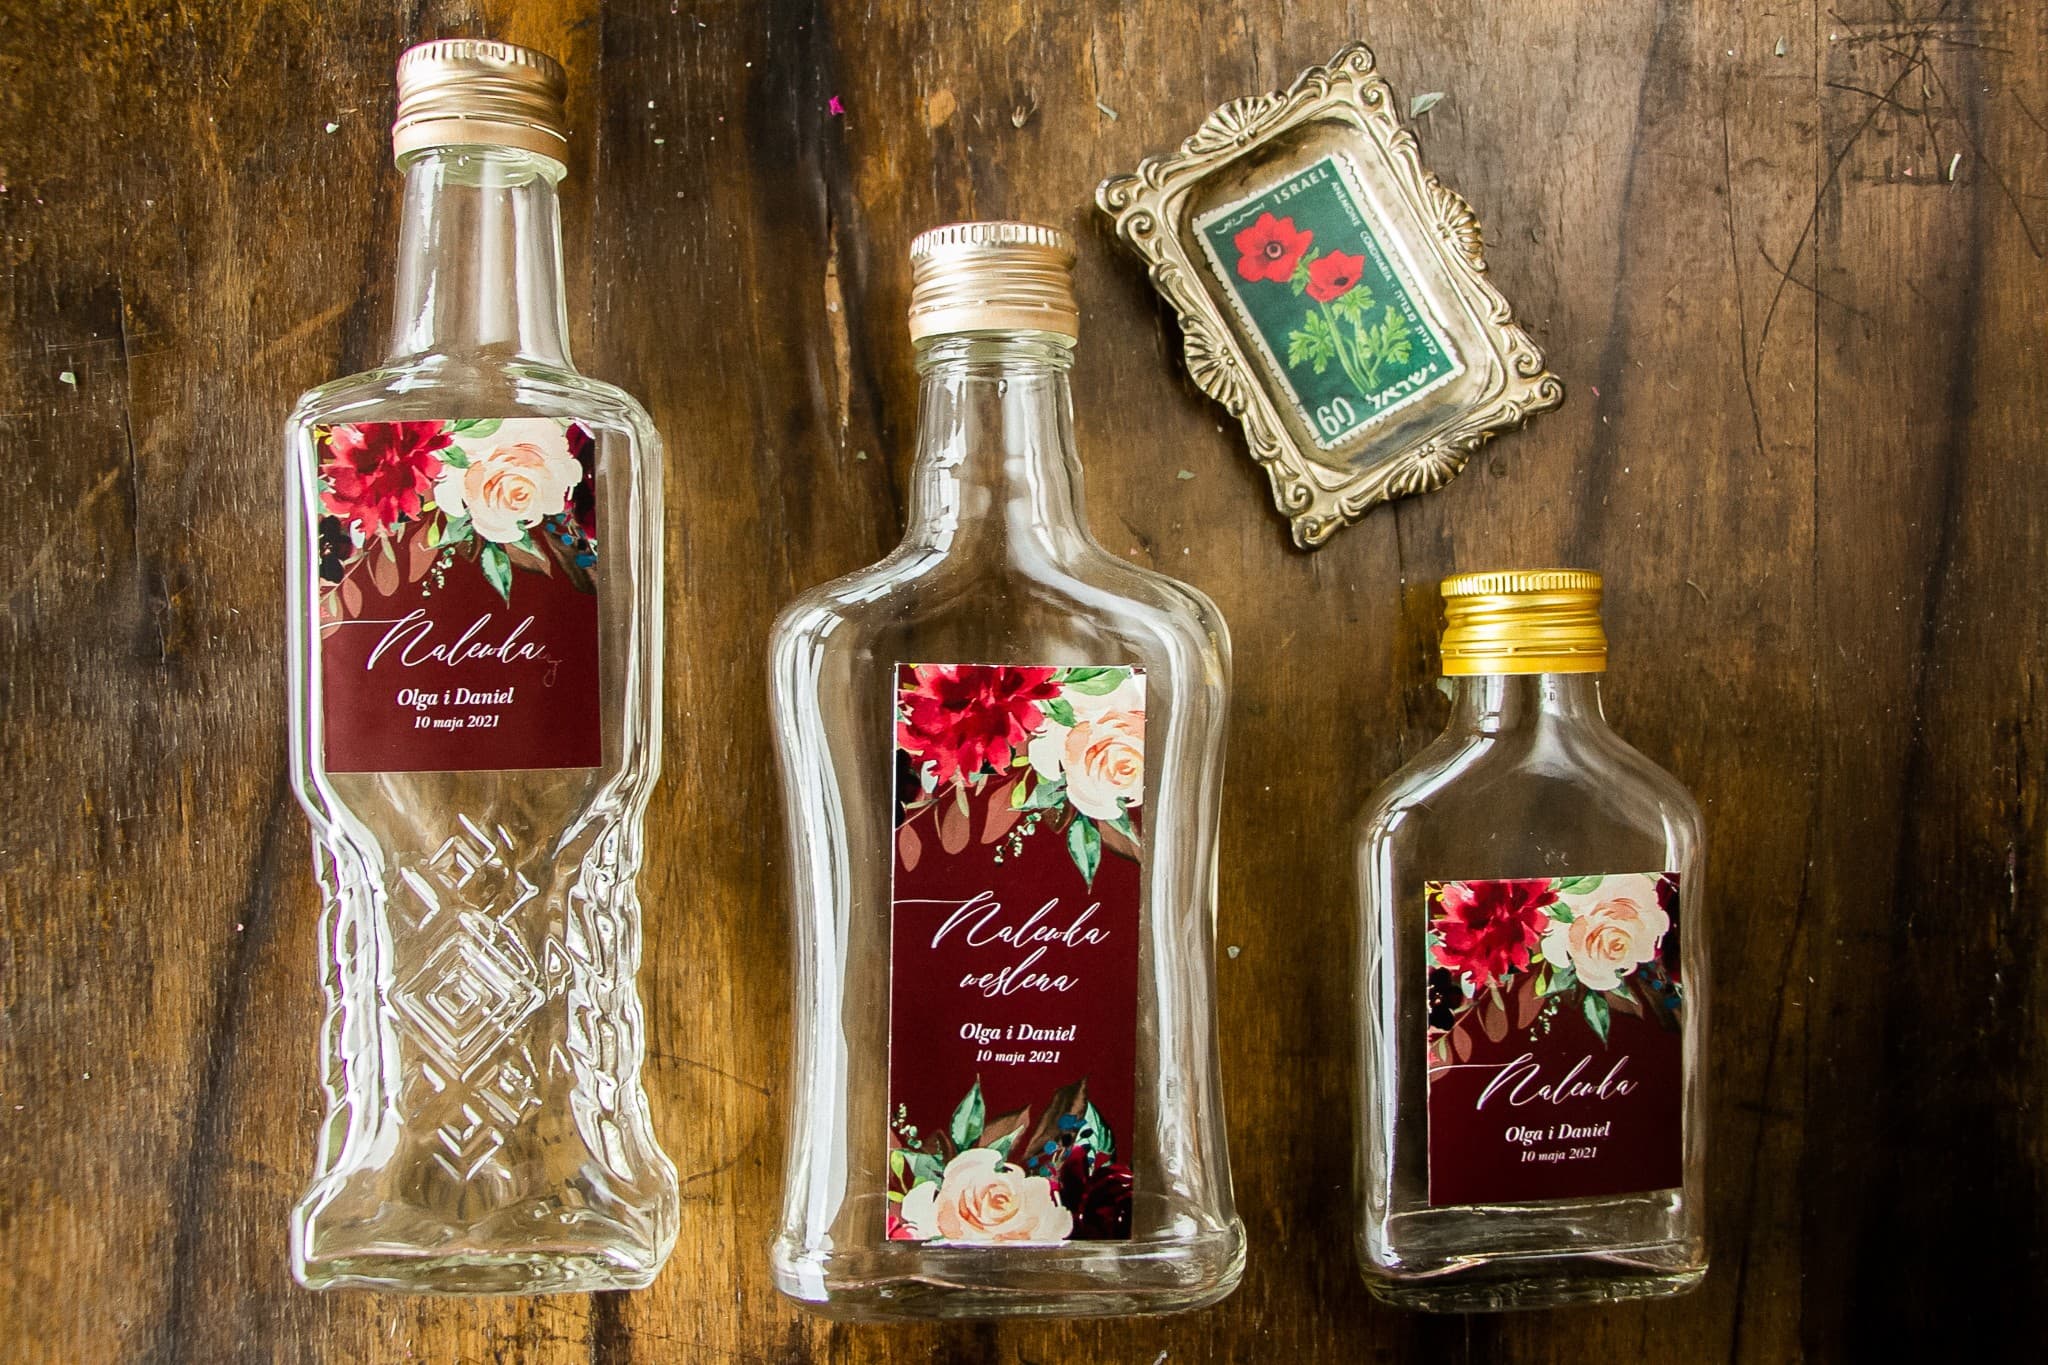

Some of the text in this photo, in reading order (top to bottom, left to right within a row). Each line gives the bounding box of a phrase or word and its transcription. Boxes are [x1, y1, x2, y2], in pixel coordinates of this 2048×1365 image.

[1273, 166, 1330, 205] ISRAEL
[1330, 181, 1392, 283] ANEMONE CORONARIA
[1364, 363, 1438, 413] ישראל
[1316, 396, 1356, 436] 60
[320, 608, 546, 671] Nalewka
[397, 687, 514, 711] Olga i Daniel
[414, 715, 500, 733] 10 maja 2021
[893, 890, 1110, 949] Nalewka
[959, 1023, 1077, 1046] Olga i Daniel
[975, 1049, 1061, 1065] 10 maja 2021
[1429, 1052, 1639, 1111] Nalewka
[1504, 1121, 1611, 1146] Olga i Daniel
[1521, 1146, 1597, 1164] 10 maja 2021
